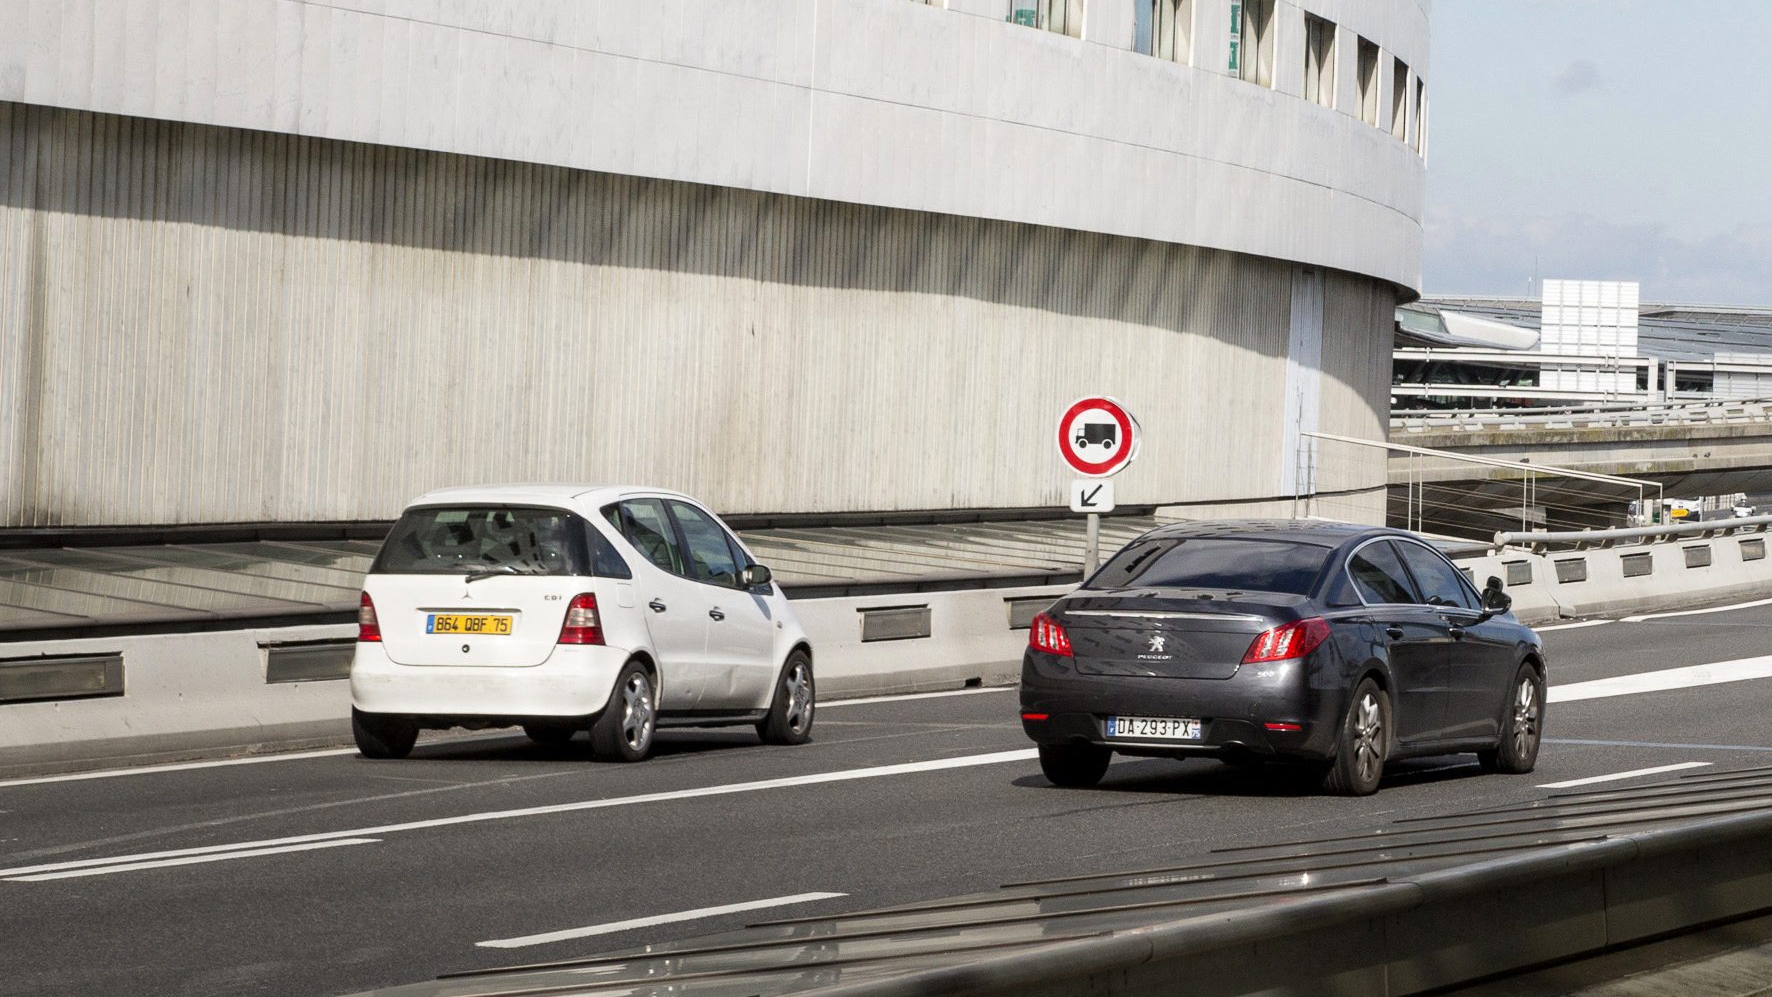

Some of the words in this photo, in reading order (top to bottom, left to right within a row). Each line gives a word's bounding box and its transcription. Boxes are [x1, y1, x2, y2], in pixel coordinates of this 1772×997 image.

[436, 617, 458, 631] 864
[465, 618, 488, 632] QBF
[494, 618, 508, 632] 75
